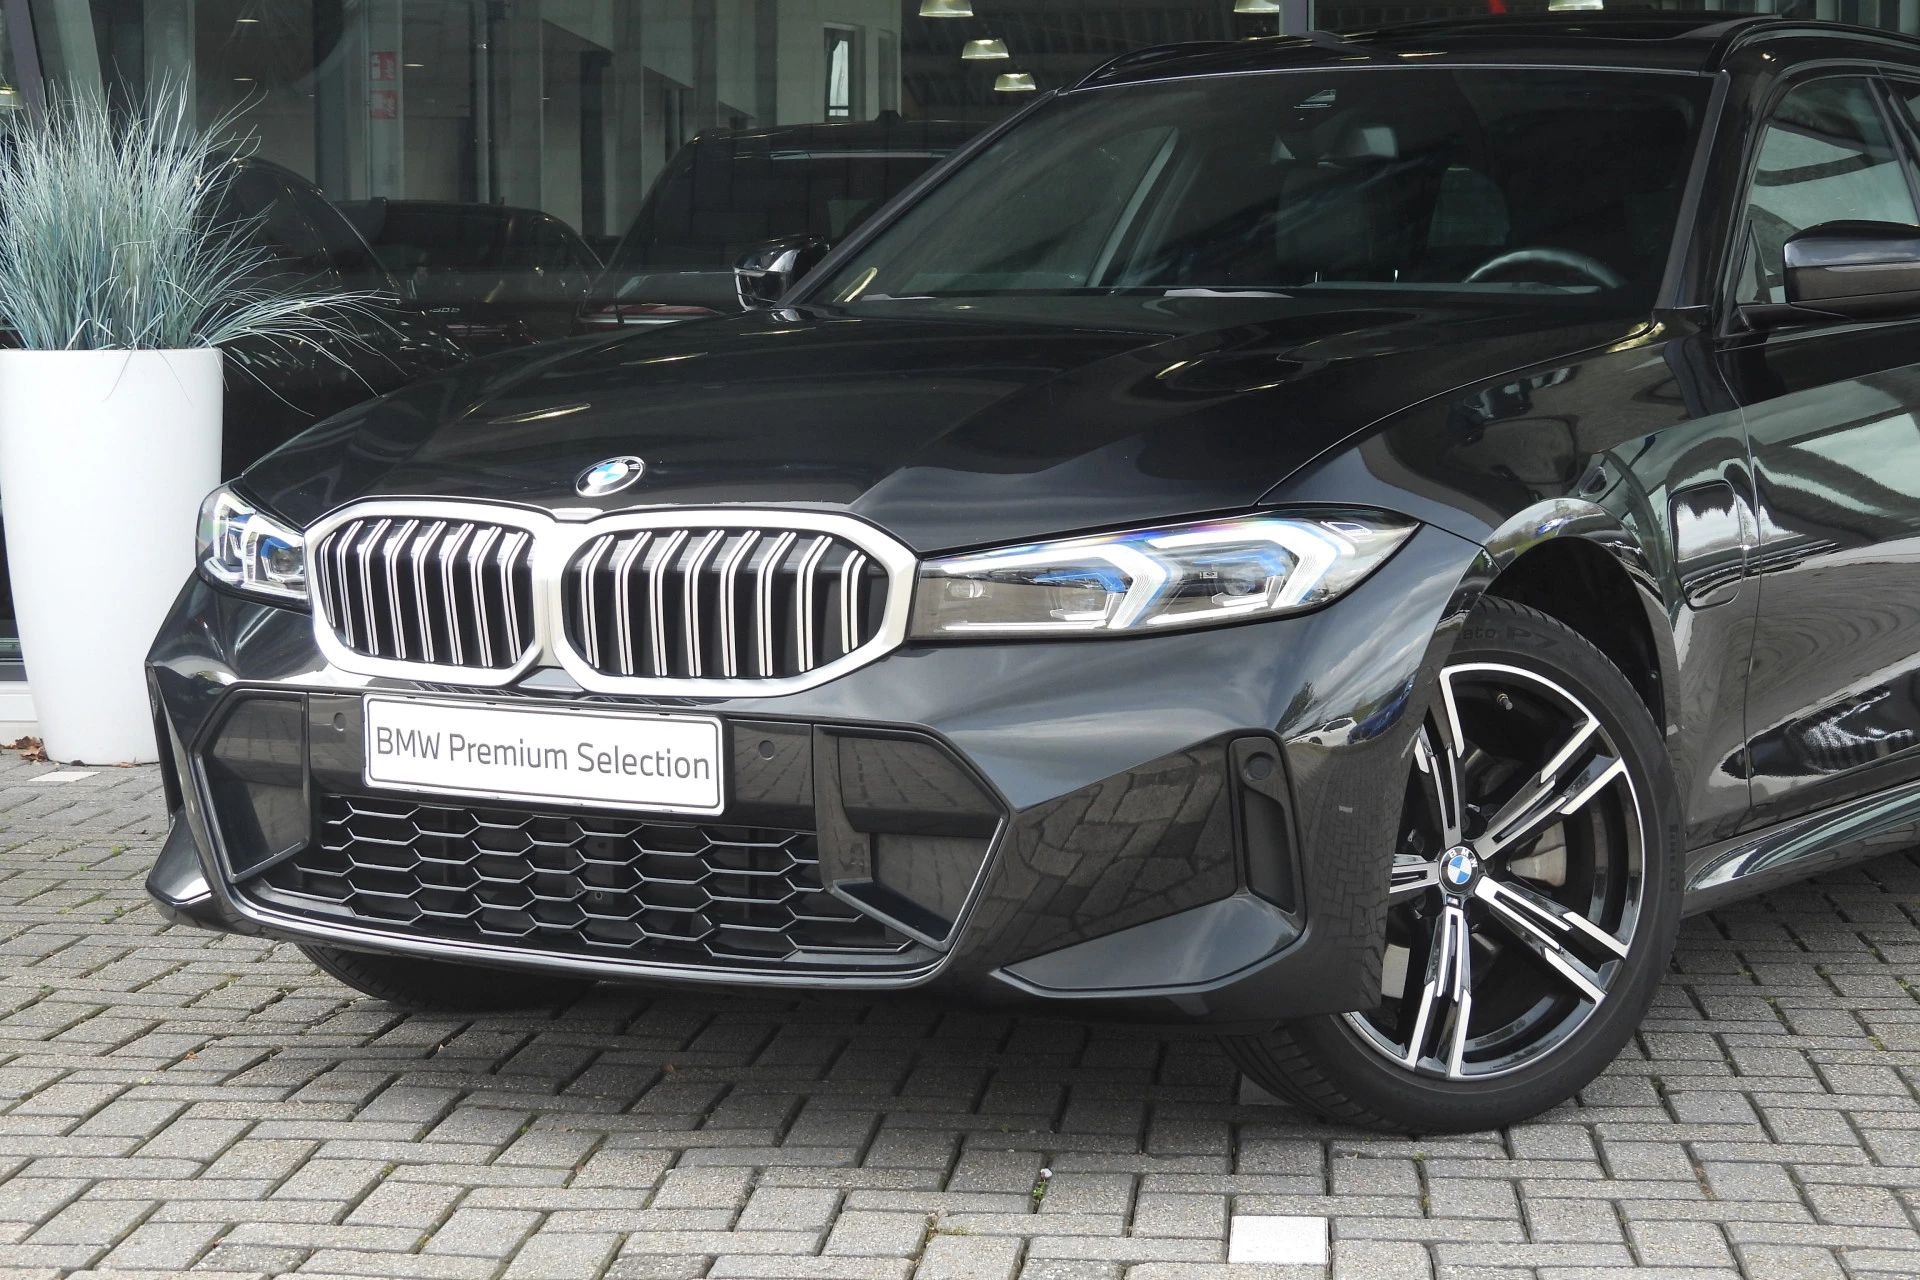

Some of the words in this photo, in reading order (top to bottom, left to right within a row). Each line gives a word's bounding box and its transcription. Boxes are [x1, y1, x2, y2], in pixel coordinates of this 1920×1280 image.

[1462, 627, 1497, 640] ato
[376, 726, 441, 760] BMW
[449, 732, 568, 771] Premium
[577, 742, 710, 780] Selection
[1448, 847, 1478, 868] BMW
